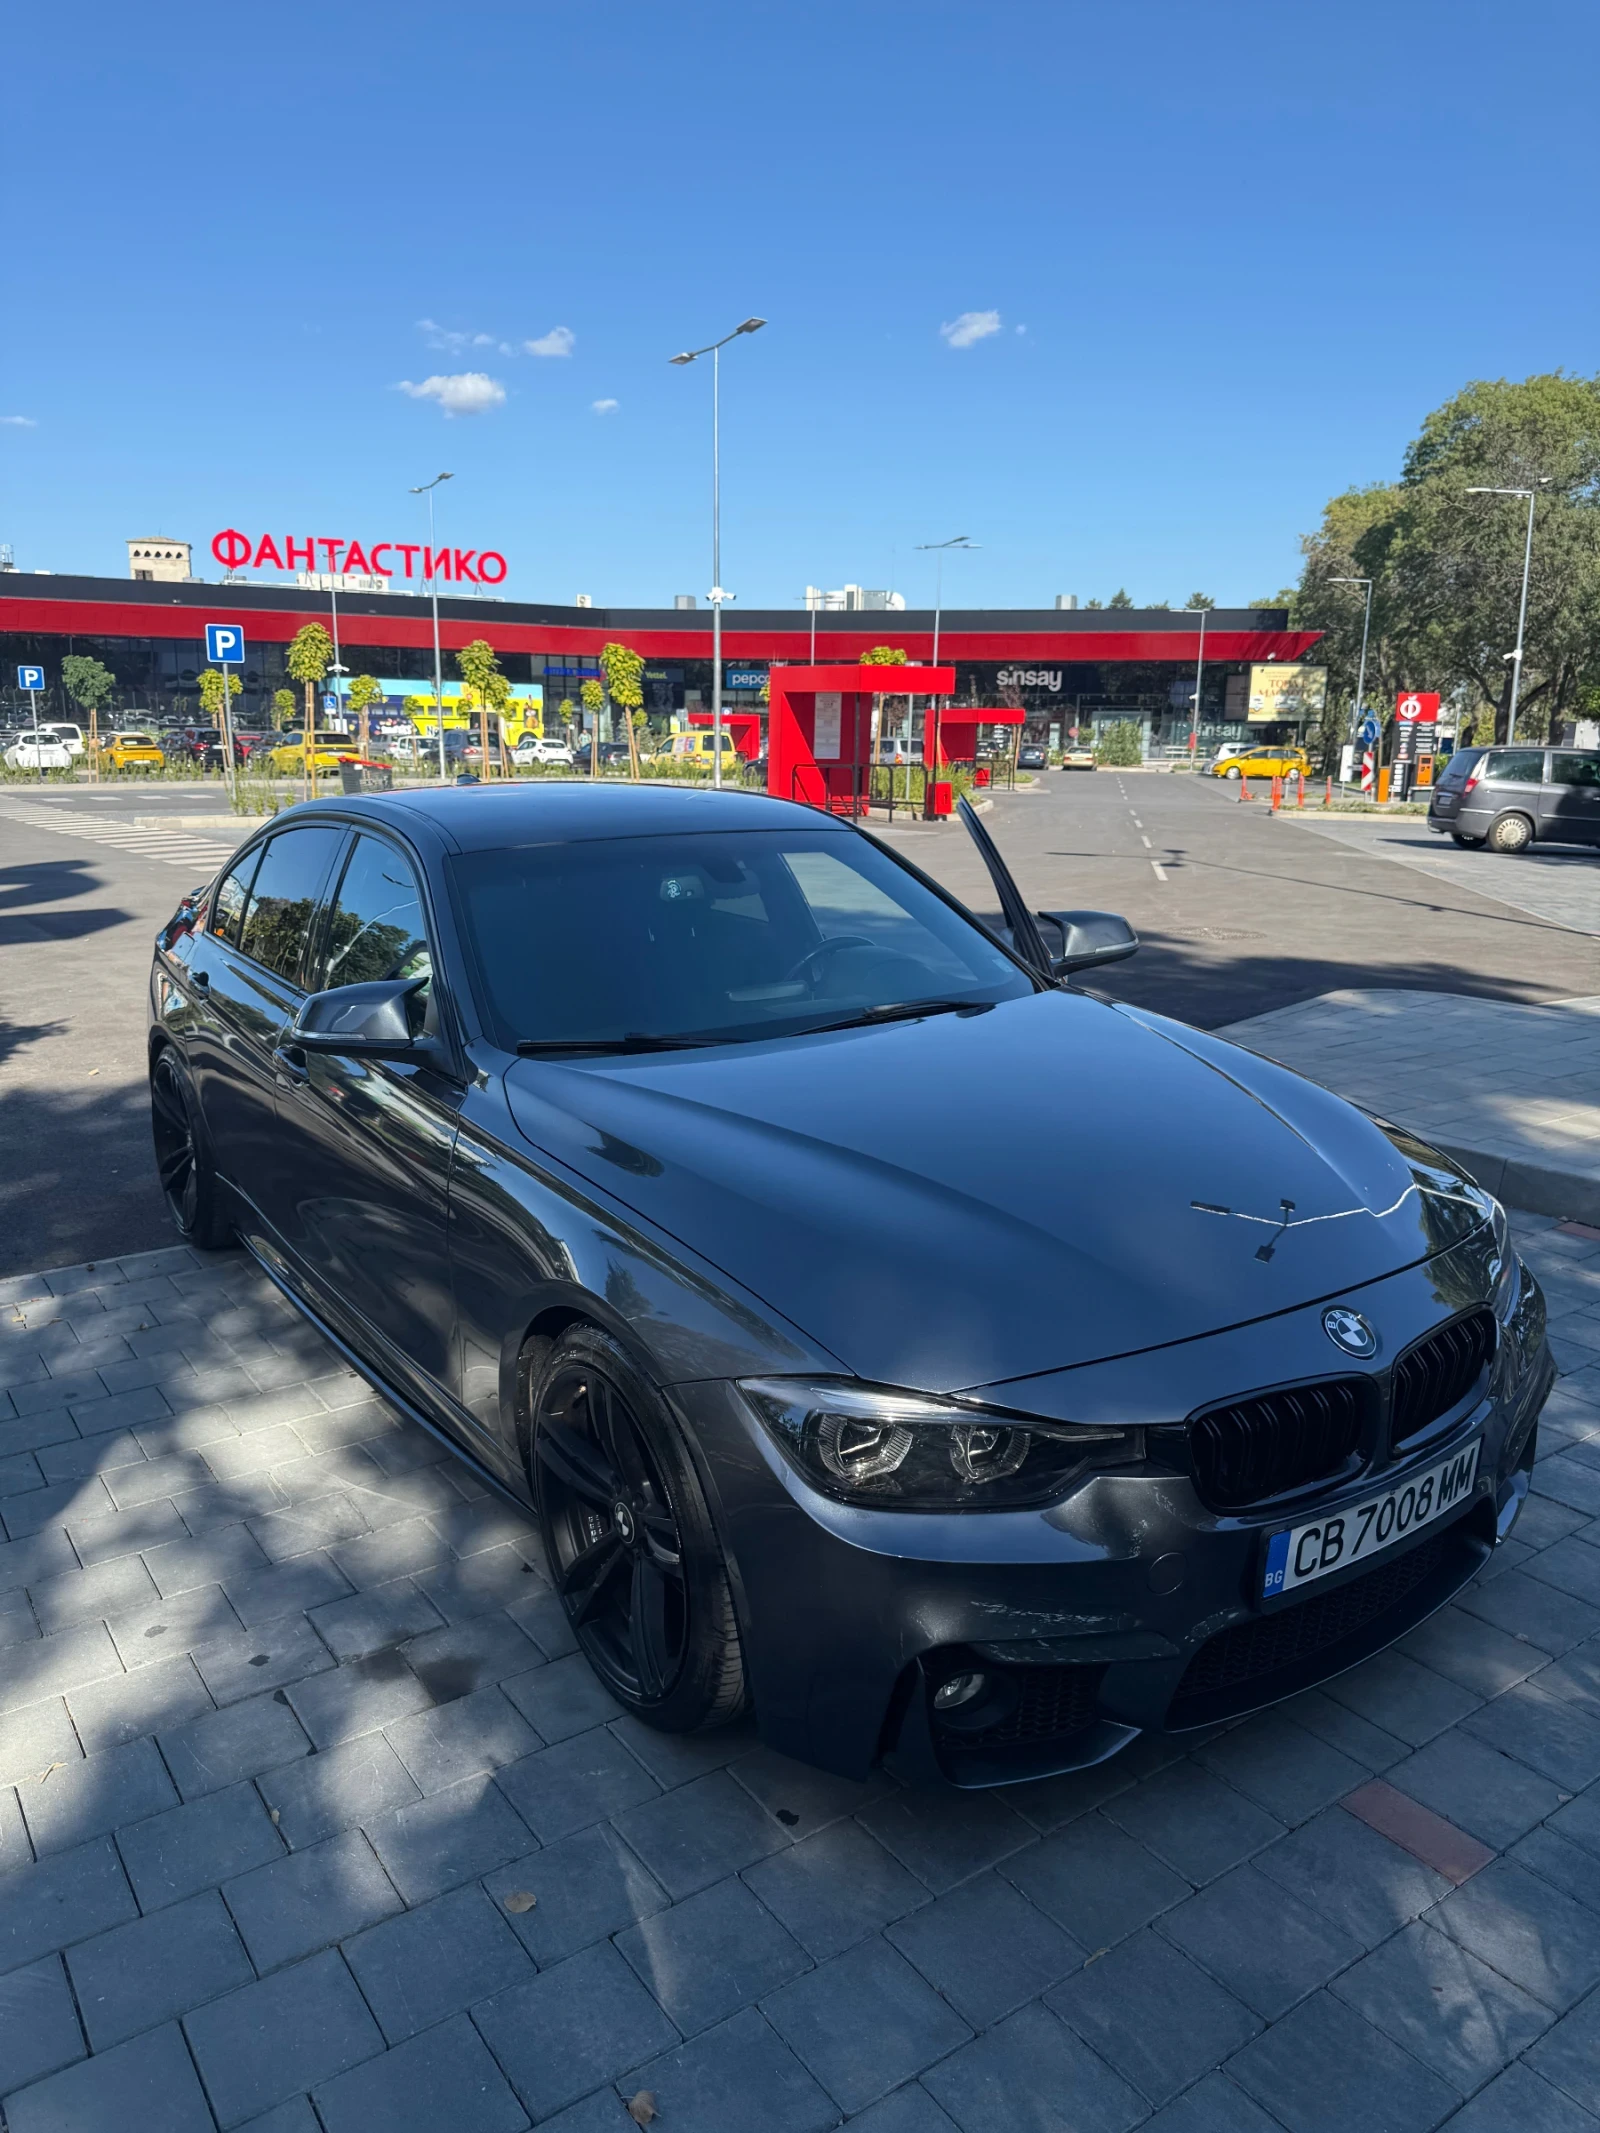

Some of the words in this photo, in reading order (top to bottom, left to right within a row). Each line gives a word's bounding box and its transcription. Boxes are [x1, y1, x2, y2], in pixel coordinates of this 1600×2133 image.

[210, 528, 508, 585] ФАНТАСТИКО
[215, 630, 236, 658] P
[24, 669, 39, 687] P
[996, 666, 1063, 692] sinsay
[1327, 1311, 1358, 1330] BMW
[1294, 1518, 1346, 1578] CB
[1350, 1475, 1435, 1557] 7008
[1436, 1446, 1476, 1512] MM
[1264, 1569, 1284, 1589] BG
